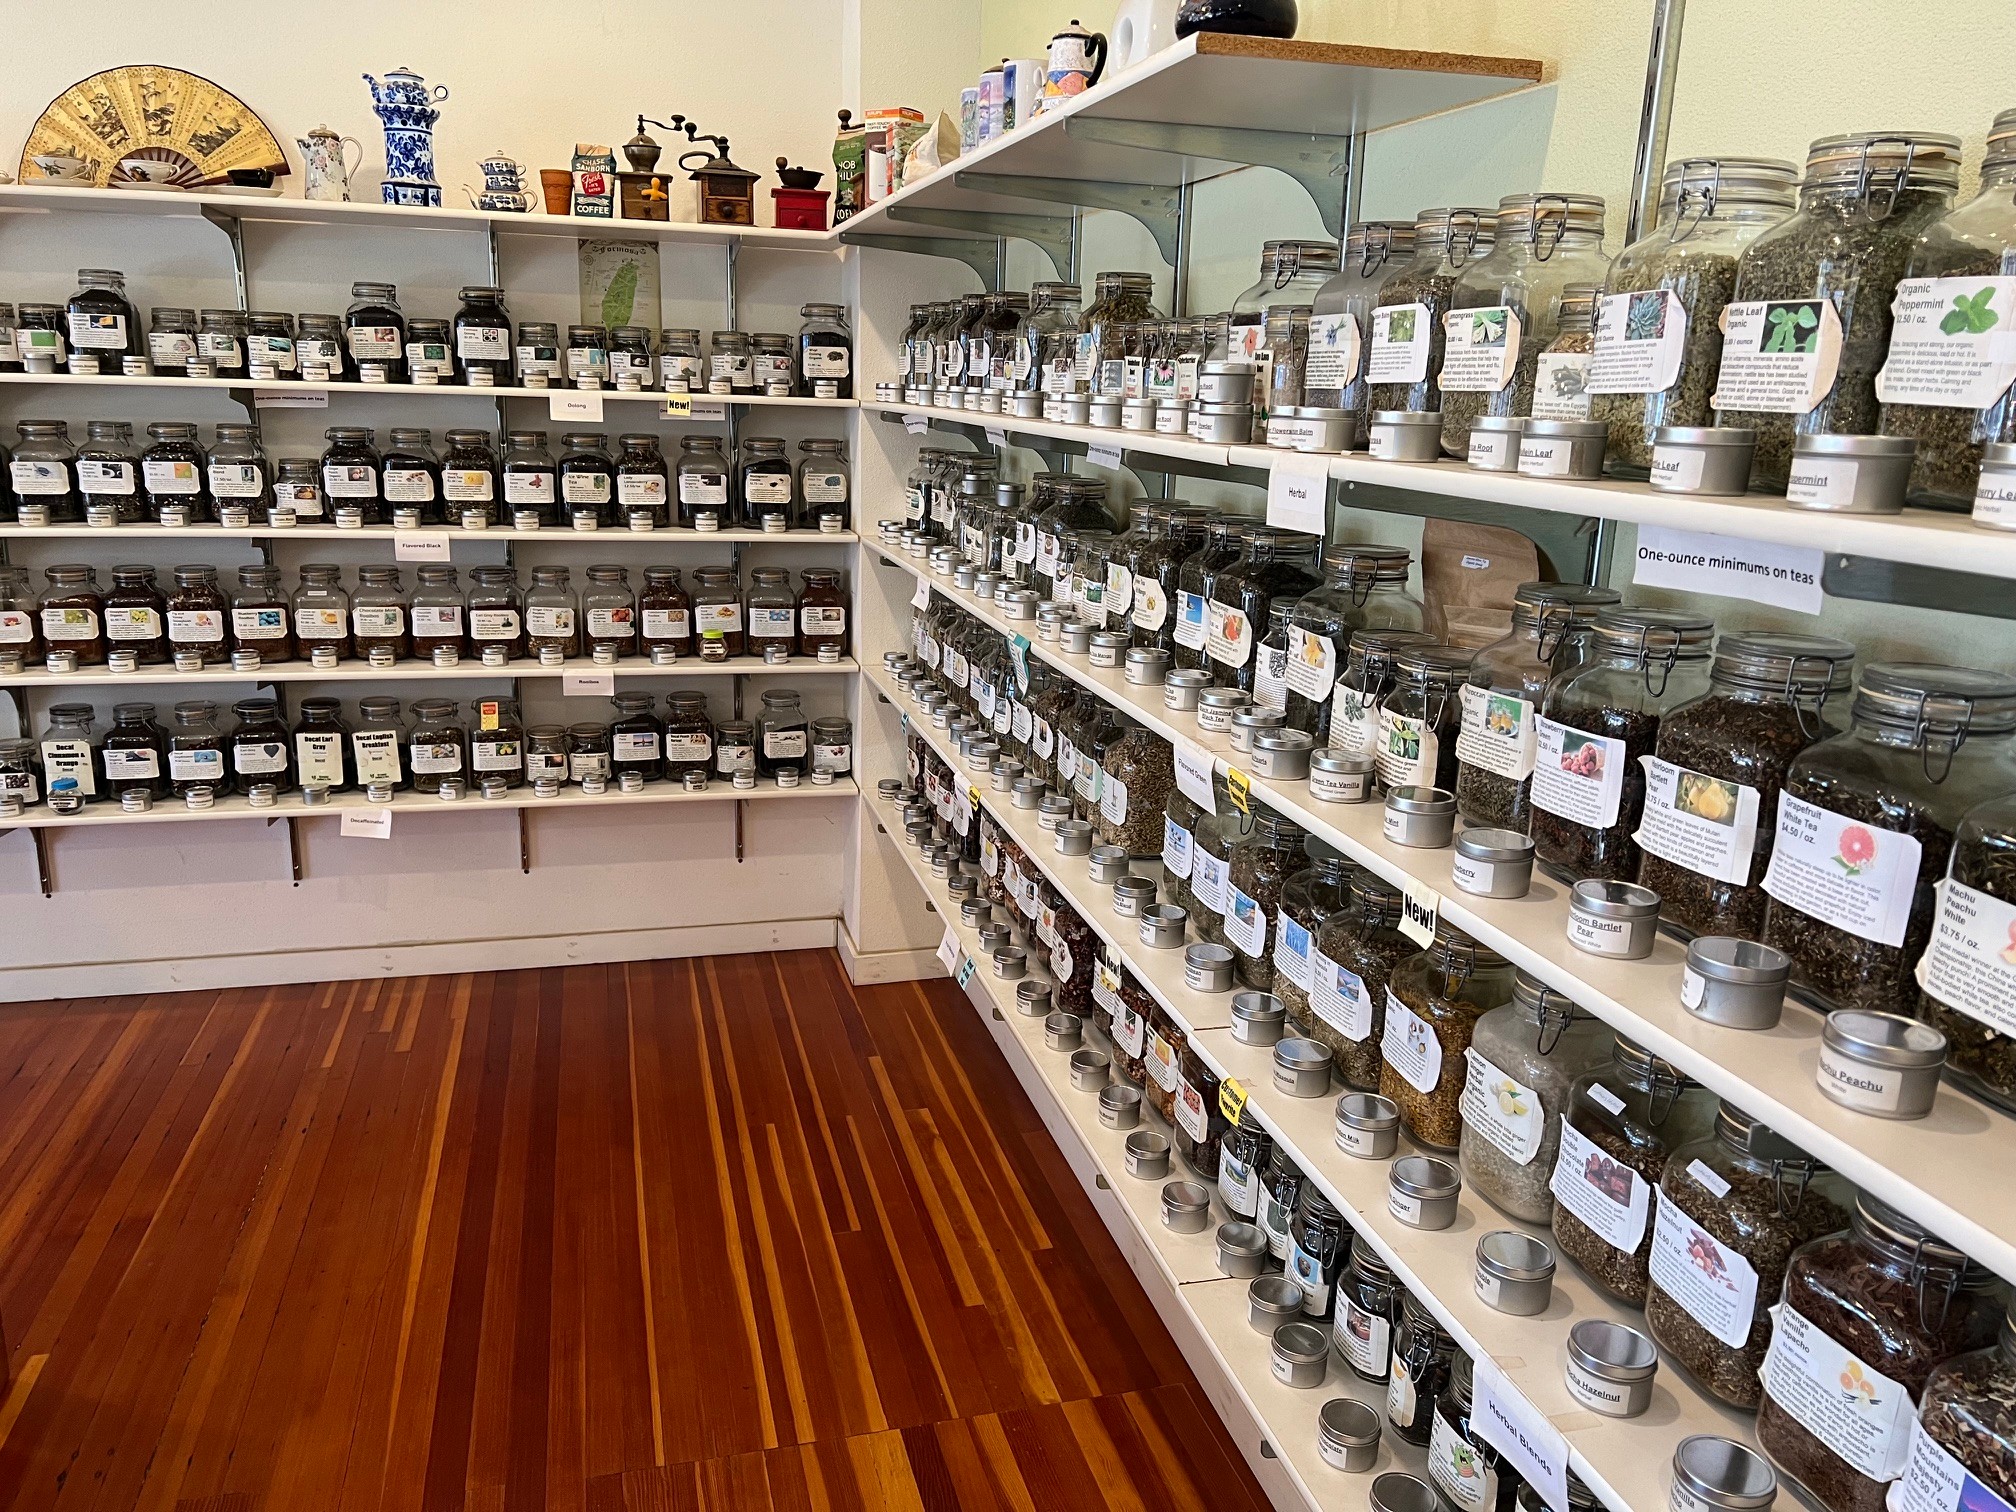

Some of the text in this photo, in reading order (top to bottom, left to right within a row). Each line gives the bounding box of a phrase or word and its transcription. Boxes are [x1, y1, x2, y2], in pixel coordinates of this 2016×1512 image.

[576, 205, 610, 214] COFFEE
[1901, 283, 1931, 296] Organic
[1746, 306, 1763, 316] Leaf
[1899, 299, 1944, 314] Peppermint
[1917, 316, 1928, 324] oz.
[567, 402, 587, 410] Oolong
[669, 399, 690, 411] New!
[1478, 443, 1493, 452] Root
[1535, 449, 1553, 458] Leaf
[1662, 462, 1680, 472] Leaf
[1288, 486, 1307, 500] Herbal
[1638, 546, 1814, 585] One-ounce minimums on teas
[1651, 760, 1675, 776] Heirloom
[1311, 776, 1360, 789] Green Tea Vanilla
[1650, 771, 1668, 785] Bartlett
[1649, 782, 1659, 793] Pear
[1661, 801, 1670, 810] oz.
[1786, 797, 1822, 820] Grapefruit
[350, 817, 385, 825] Decaffeinated
[1784, 809, 1818, 831] White Tea
[1781, 822, 1816, 845] $4.50 oz.
[1949, 883, 1976, 904] Machu
[1405, 893, 1434, 932] New!
[1946, 895, 1977, 918] Peachu
[1944, 907, 1966, 926] White
[1577, 925, 1594, 938] Pear
[1592, 920, 1622, 933] Bartlet
[1940, 923, 1961, 942] $3.75
[1967, 938, 1980, 950] oz.
[1107, 955, 1121, 978] New!
[2000, 967, 2011, 979] the
[1470, 1051, 1486, 1069] Lemon
[1469, 1061, 1484, 1078] Ginger
[1467, 1078, 1485, 1098] Organic
[1839, 1070, 1883, 1093] Peachu
[1221, 1080, 1243, 1107] Customer
[1347, 1134, 1360, 1145] Milk
[1561, 1145, 1584, 1168] Chocolate
[1575, 1166, 1583, 1177] oz.
[1660, 1197, 1678, 1219] Mocha
[1659, 1207, 1683, 1235] Hazelnut
[1673, 1245, 1682, 1257] oz.
[1784, 1305, 1809, 1331] Orange
[1783, 1316, 1805, 1339] Vanilla
[1781, 1325, 1810, 1354] Lapacho
[1582, 1381, 1620, 1402] Hazelnut
[1488, 1400, 1553, 1477] Herbal Blends
[1918, 1430, 1944, 1462] Purple
[1913, 1455, 1944, 1493] Majesty
[1915, 1442, 1960, 1491] Mountains
[1910, 1466, 1930, 1493] $2.50
